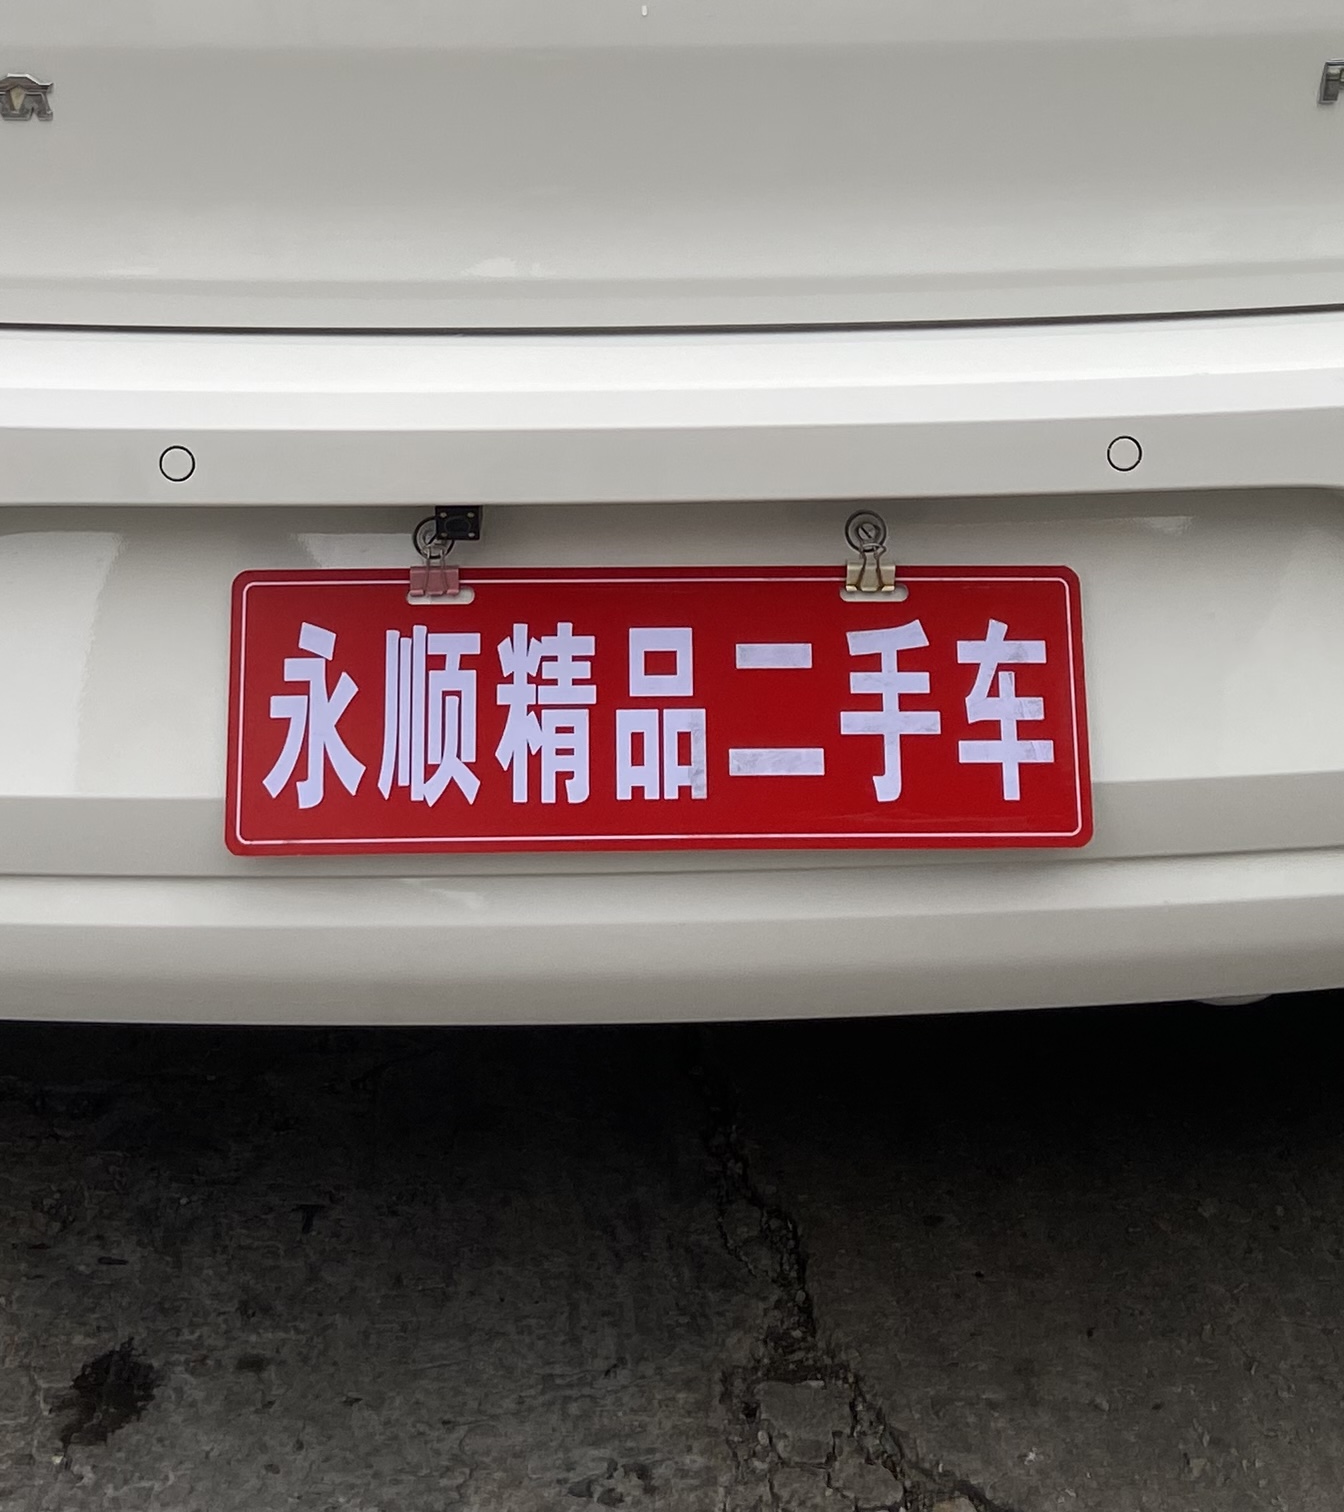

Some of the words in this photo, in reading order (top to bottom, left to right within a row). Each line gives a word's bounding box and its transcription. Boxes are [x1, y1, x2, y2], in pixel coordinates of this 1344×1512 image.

[261, 618, 1055, 810] 永顺精品二手车
